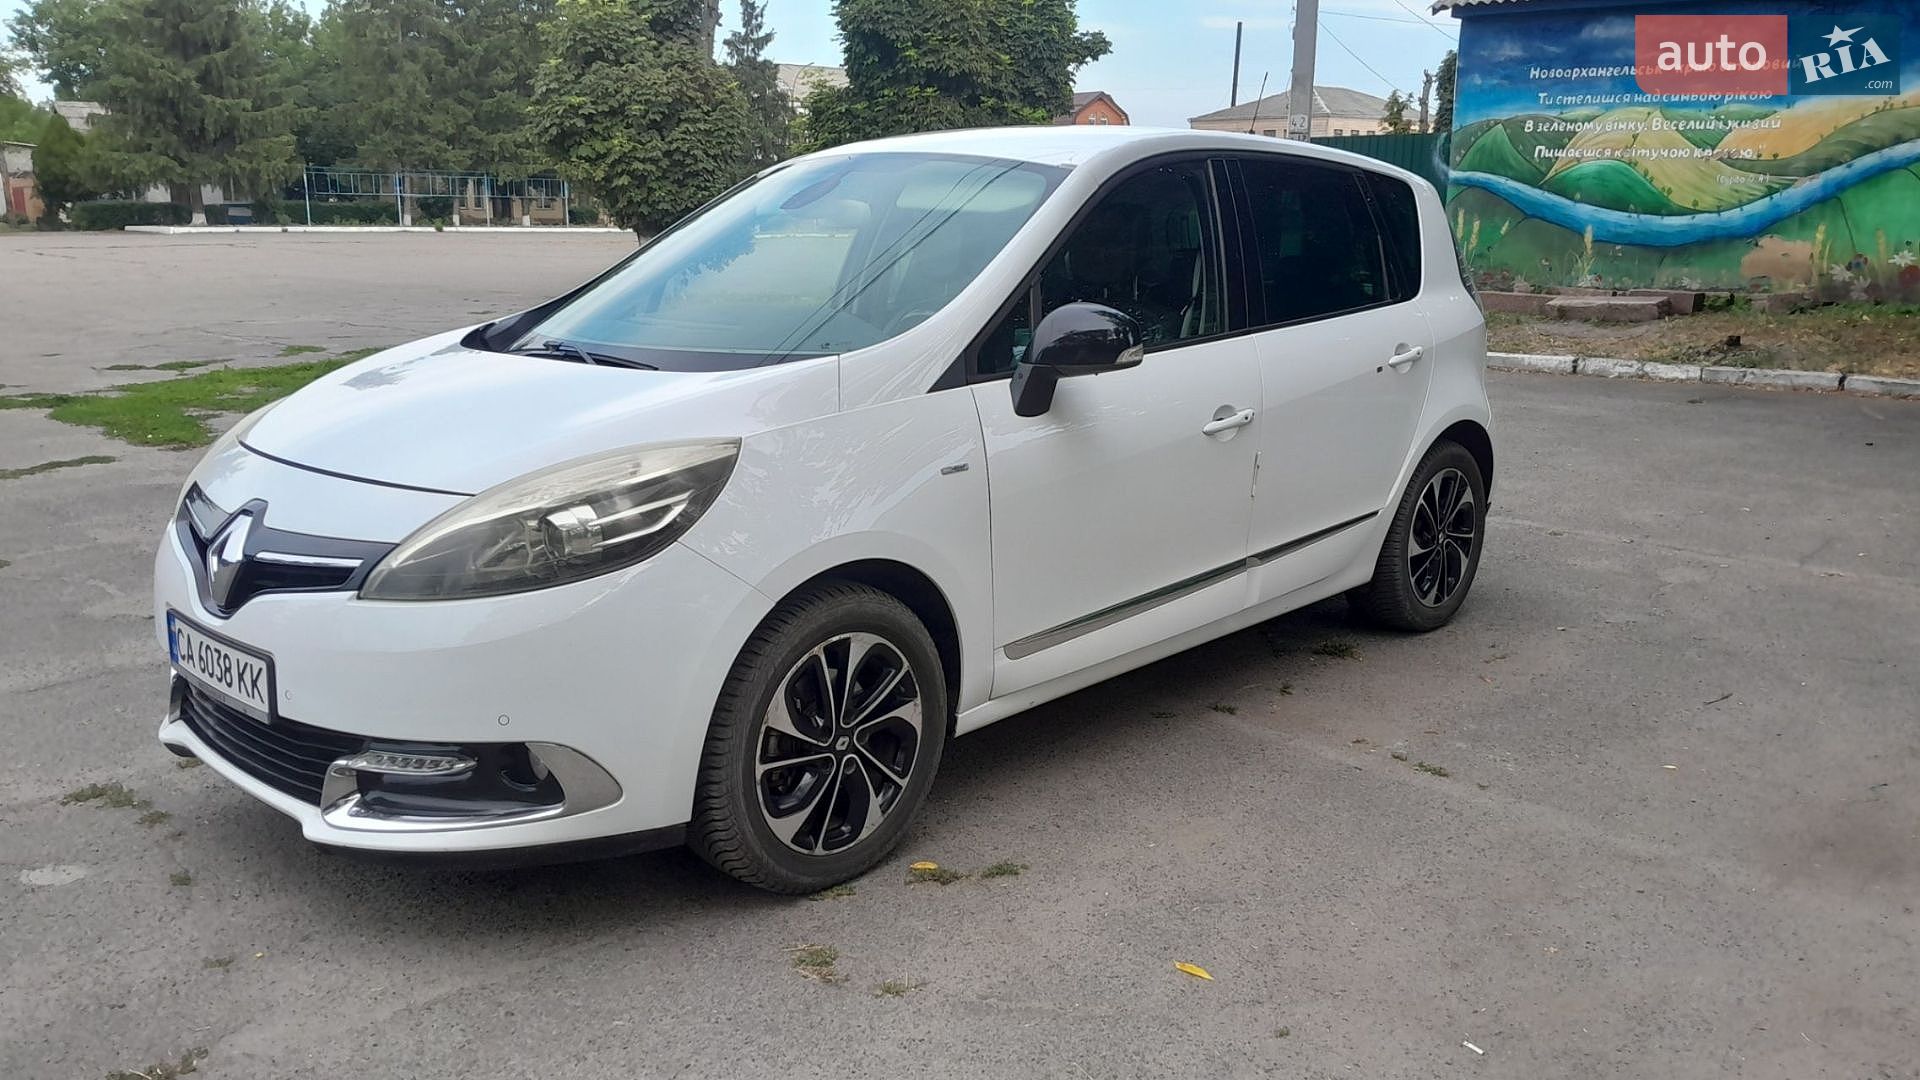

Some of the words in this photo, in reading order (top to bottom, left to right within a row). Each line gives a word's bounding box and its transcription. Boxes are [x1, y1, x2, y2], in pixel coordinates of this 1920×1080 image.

[1524, 119, 1534, 132] В
[1651, 116, 1715, 131] Веселий
[198, 641, 233, 688] 6038
[237, 658, 265, 704] KK
